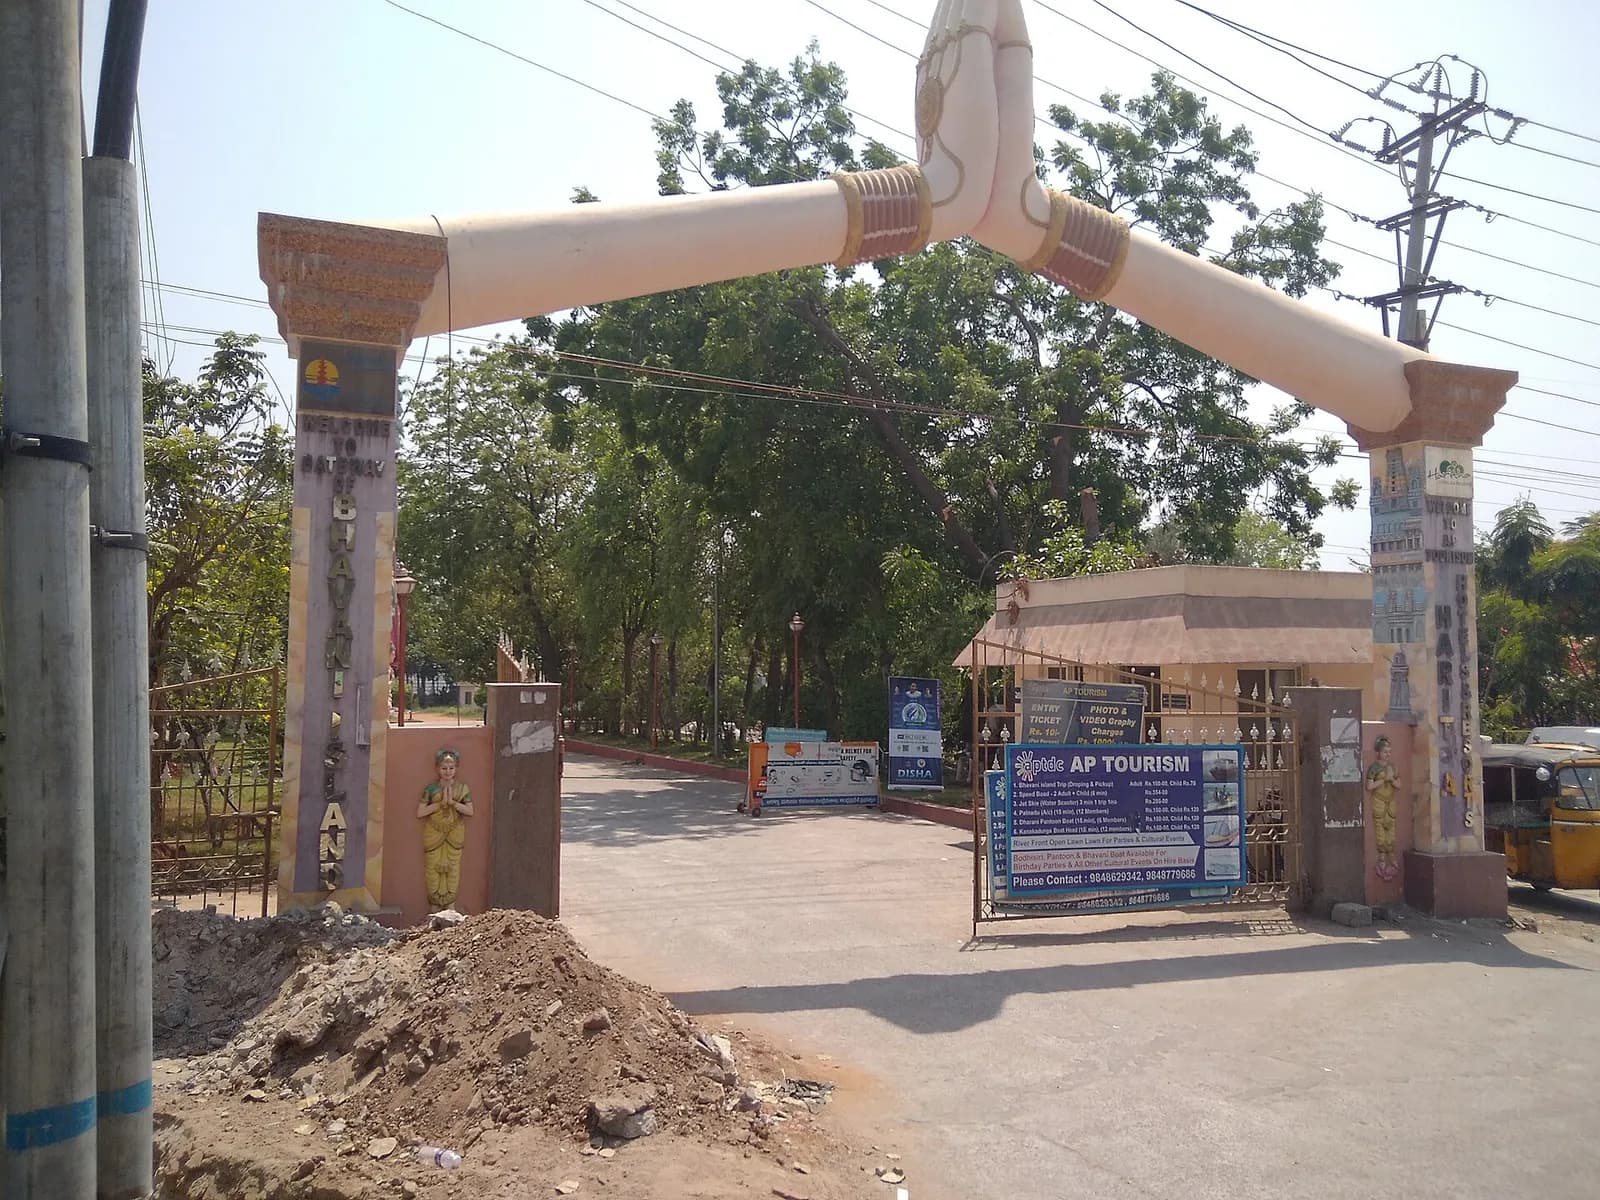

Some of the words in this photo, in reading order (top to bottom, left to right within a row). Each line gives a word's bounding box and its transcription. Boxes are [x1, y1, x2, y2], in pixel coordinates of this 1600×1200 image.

[1063, 687, 1073, 695] AP
[1075, 688, 1107, 696] TOURISM
[1032, 704, 1060, 713] ENTRY
[1090, 706, 1119, 715] PHOTO
[1030, 716, 1061, 724] TICKET
[1080, 716, 1106, 724] VIDEO
[1108, 718, 1136, 727] Graphy
[1023, 756, 1065, 775] aptdc
[1070, 756, 1097, 773] AP
[1102, 756, 1190, 773] TOURISM
[898, 769, 932, 778] DISHA
[319, 710, 351, 891] SLAND
[1031, 839, 1048, 847] Front
[1049, 839, 1066, 847] Open
[1083, 851, 1109, 859] Bhavani
[1110, 850, 1125, 858] Boat
[1013, 863, 1041, 871] Birthday
[1013, 876, 1045, 887] Please
[1046, 874, 1082, 885] Contact
[1089, 871, 1144, 884] 9848629342,
[1145, 869, 1196, 880] 9848779686
